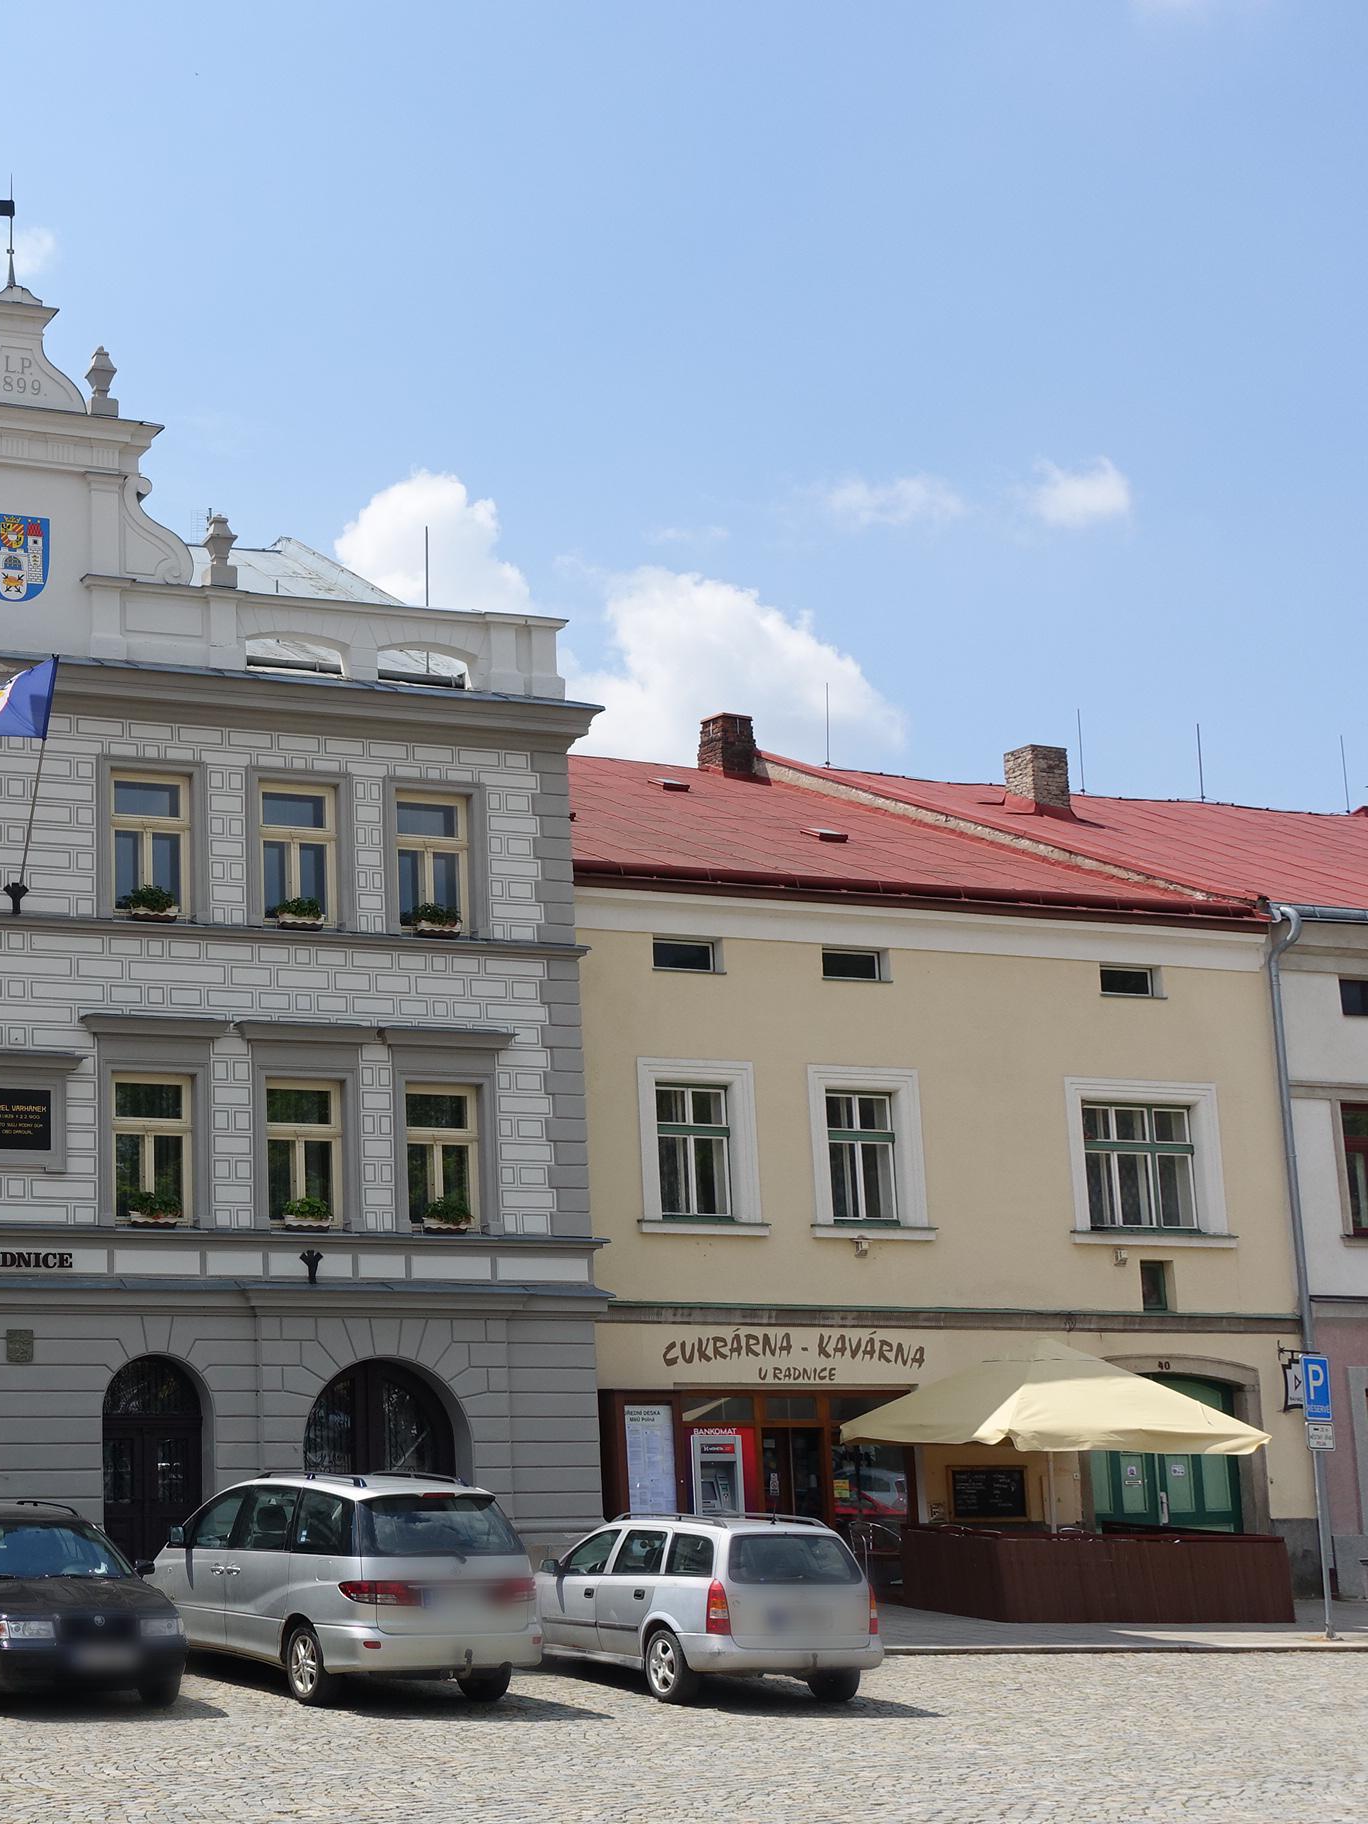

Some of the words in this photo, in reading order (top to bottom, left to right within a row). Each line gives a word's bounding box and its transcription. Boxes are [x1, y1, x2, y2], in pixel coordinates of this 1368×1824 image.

[662, 1328, 793, 1367] CUKRÁRNA
[817, 1330, 926, 1370] KAVÁRNA
[758, 1366, 768, 1381] U
[772, 1367, 837, 1382] RADNICE
[1307, 1364, 1324, 1400] P
[693, 1427, 737, 1436] BANKOMAT
